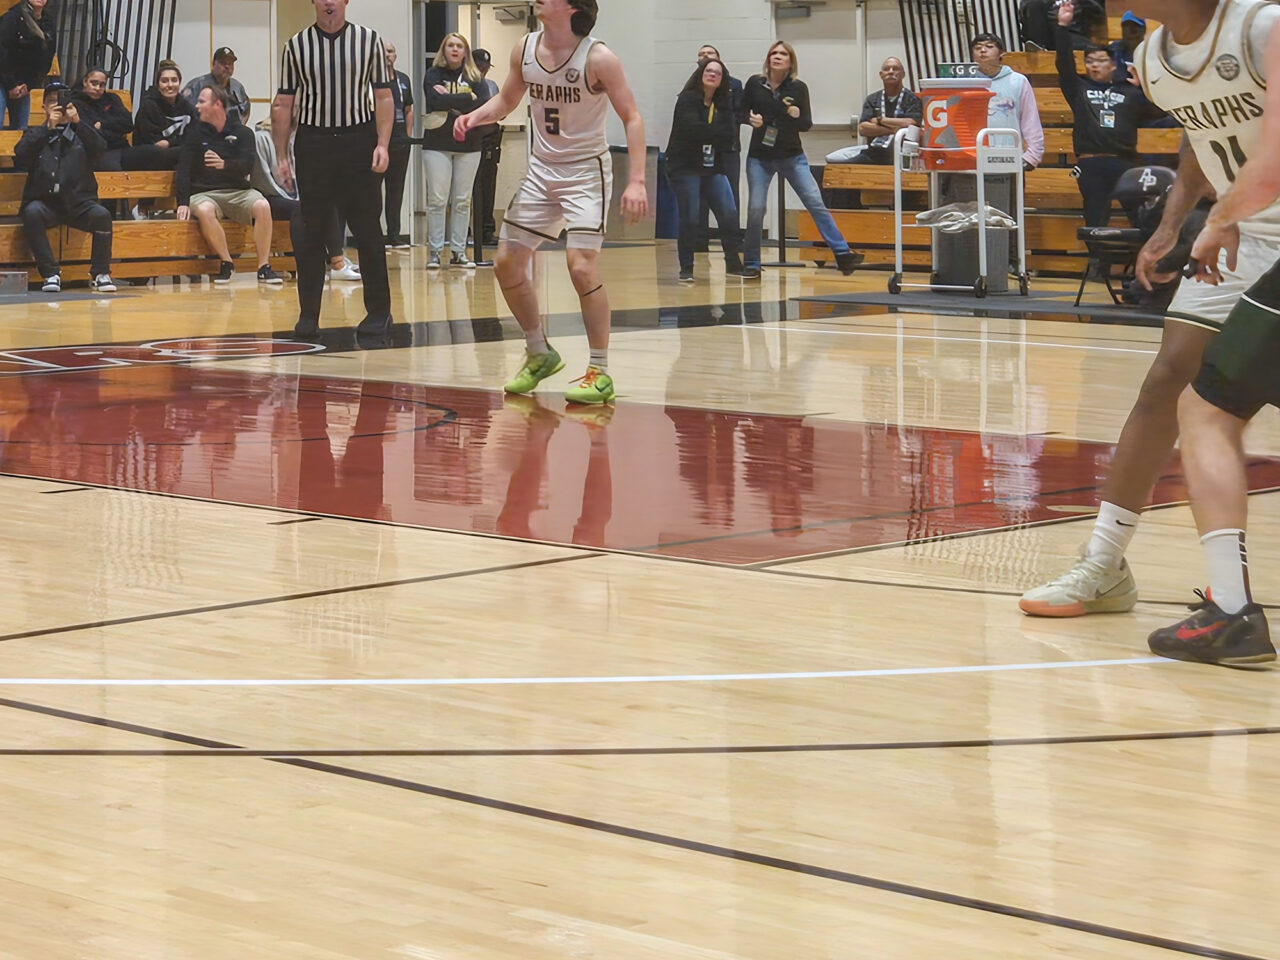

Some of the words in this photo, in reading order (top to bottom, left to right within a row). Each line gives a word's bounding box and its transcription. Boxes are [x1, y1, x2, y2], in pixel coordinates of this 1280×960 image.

[528, 82, 581, 104] ERAPHS
[544, 107, 560, 136] 5
[926, 99, 949, 129] G
[1169, 92, 1264, 130] ERAPHS
